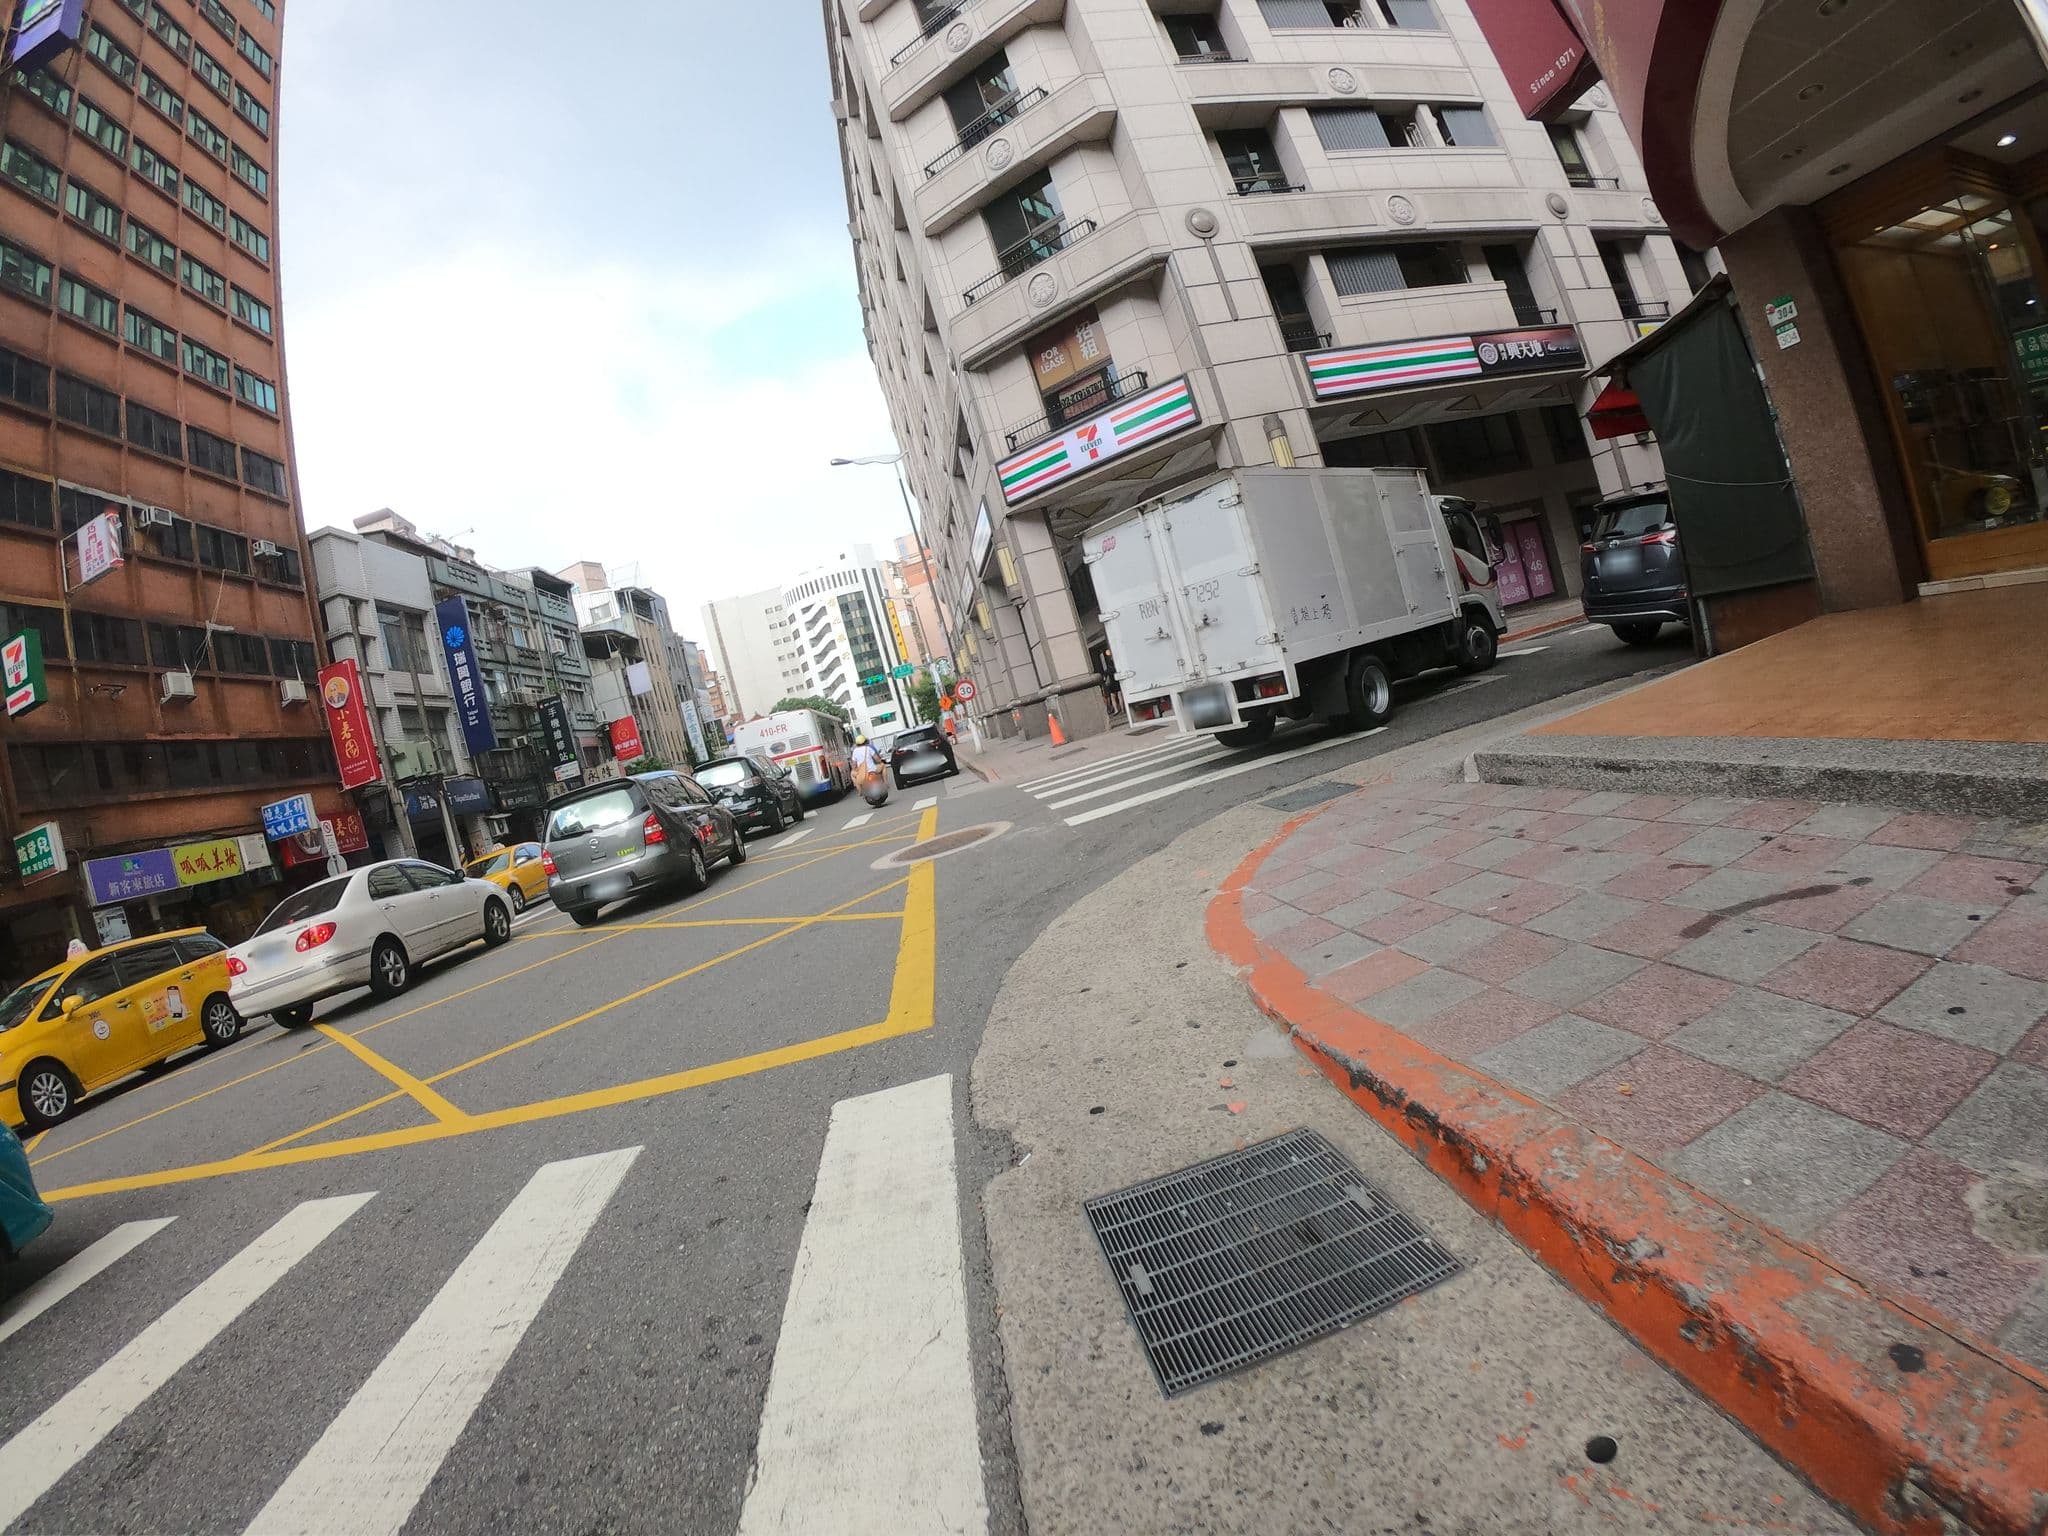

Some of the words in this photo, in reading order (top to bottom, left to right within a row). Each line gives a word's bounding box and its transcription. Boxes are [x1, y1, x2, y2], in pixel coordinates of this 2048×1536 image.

[1530, 70, 1555, 94] Since
[1555, 47, 1576, 71] 1971
[1777, 305, 1794, 320] 304
[1076, 321, 1099, 360] 招租
[1780, 331, 1797, 346] 304
[1041, 346, 1058, 362] FOR
[1040, 355, 1066, 374] LEASE
[1192, 580, 1219, 603] 7292
[960, 686, 972, 695] 30
[759, 724, 788, 738] 410-FR
